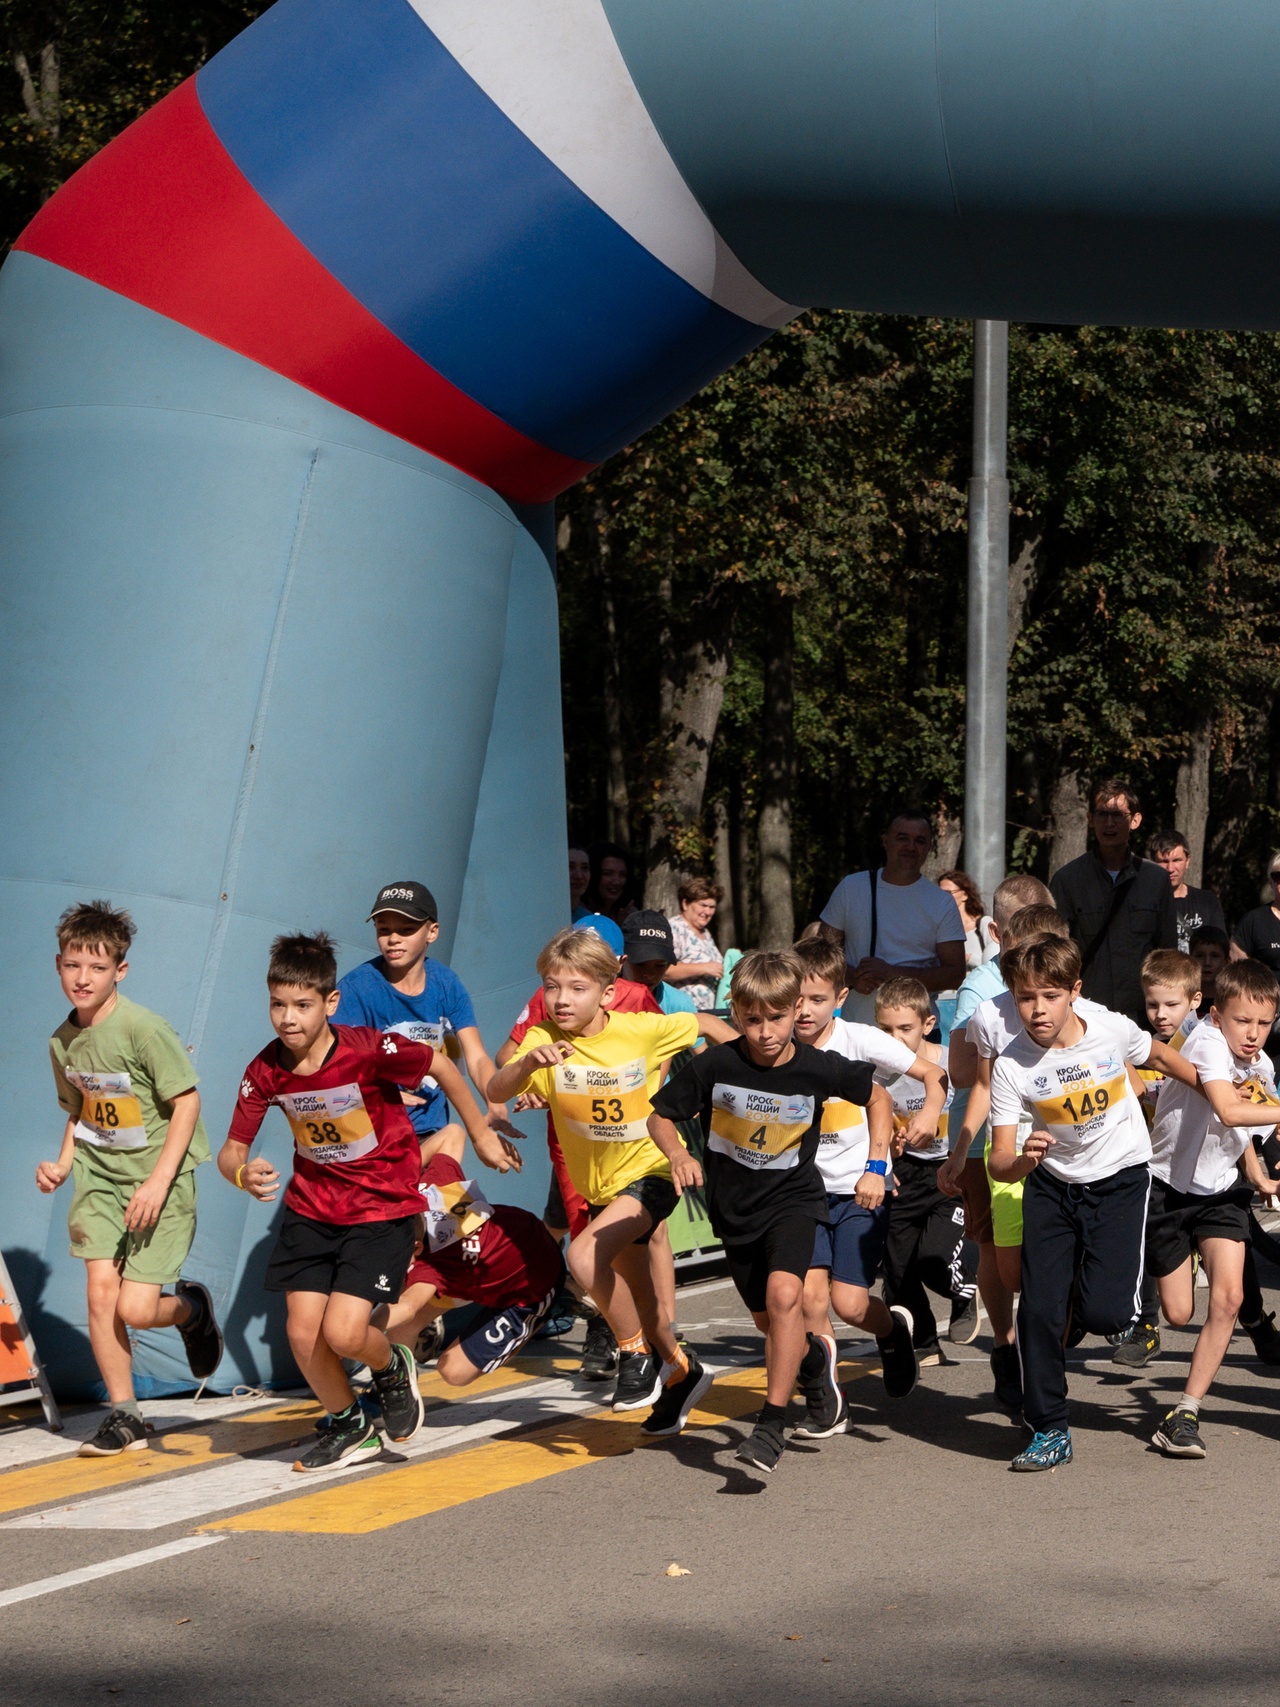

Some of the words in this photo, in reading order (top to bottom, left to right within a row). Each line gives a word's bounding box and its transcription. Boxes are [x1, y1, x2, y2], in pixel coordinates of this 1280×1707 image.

[382, 888, 414, 898] BOSS
[640, 929, 667, 939] BOSS
[409, 1026, 432, 1034] КРОСС
[410, 1033, 439, 1041] НАЦИИ
[586, 1070, 610, 1079] КРОСС
[1056, 1063, 1081, 1077] КРОСС
[586, 1078, 619, 1087] НАЦИИ
[1058, 1069, 1092, 1085] НАЦИИ
[588, 1086, 621, 1095] 2024
[1062, 1077, 1096, 1093] 2024
[292, 1096, 317, 1105] КРОСС
[747, 1094, 774, 1106] КРОСС
[1062, 1088, 1109, 1122] 149
[95, 1101, 119, 1127] 48
[295, 1103, 327, 1113] НАЦИИ
[591, 1098, 624, 1123] 53
[745, 1102, 780, 1114] НАЦИИ
[745, 1111, 780, 1122] 2024
[306, 1122, 342, 1145] 38
[749, 1125, 767, 1150] 4
[309, 1144, 349, 1154] РЯЗАНСКАЯ
[734, 1145, 774, 1160] РЯЗАНСКАЯ
[485, 1315, 513, 1344] 5
